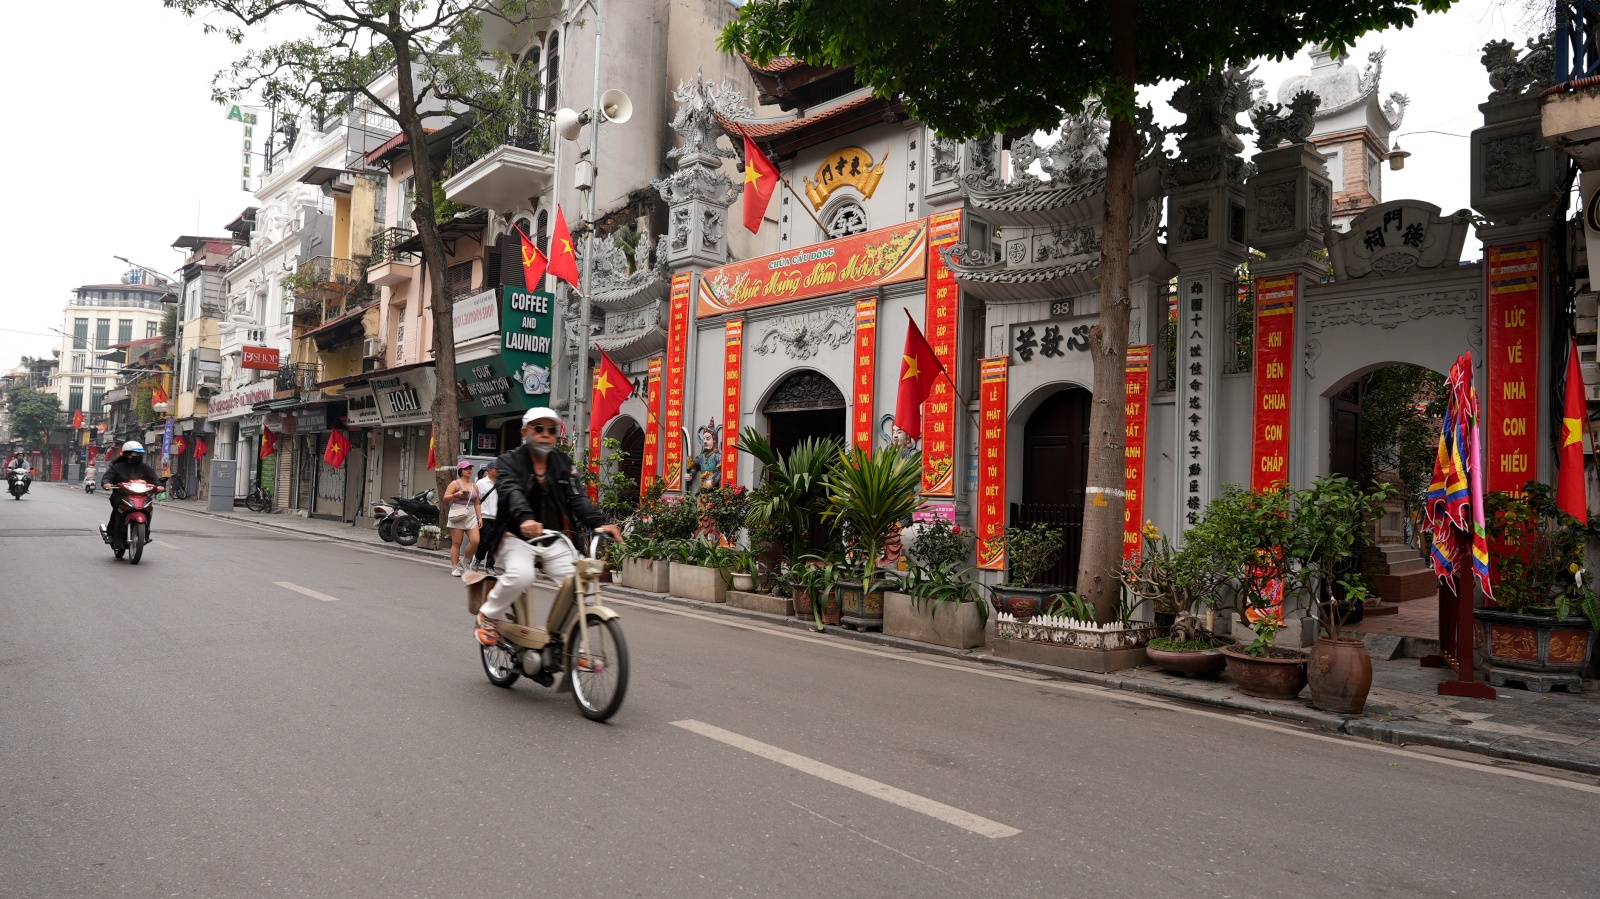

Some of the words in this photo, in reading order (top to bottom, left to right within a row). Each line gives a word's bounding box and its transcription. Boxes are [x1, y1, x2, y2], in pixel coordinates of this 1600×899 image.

[227, 105, 257, 125] A25
[243, 125, 253, 192] HOTEL
[768, 256, 790, 270] CHÙA
[733, 279, 763, 304] Chúc
[762, 269, 802, 297] Mừng
[804, 262, 838, 288] Năm
[511, 292, 548, 314] COFFEE
[1052, 302, 1070, 315] 38
[522, 316, 537, 329] AND
[1504, 304, 1526, 328] LÚC
[505, 331, 551, 354] LAUNDRY
[1268, 331, 1282, 348] KHI
[1507, 338, 1522, 364] VỀ
[471, 364, 492, 380] TOUR
[1266, 356, 1283, 379] ĐẾN
[466, 377, 511, 396] INFORMATION
[1126, 381, 1140, 398] IỆM
[1503, 376, 1527, 400] NHÀ
[387, 383, 417, 413] HOÀI
[480, 393, 507, 408] CENTRE
[1263, 389, 1286, 410] CHÙA
[986, 407, 1001, 422] PHẬT
[986, 425, 1001, 439] NHẤT
[1265, 425, 1282, 441] CON
[1503, 417, 1526, 436] CON
[932, 442, 945, 452] LAM
[1125, 446, 1141, 458] ANH
[1261, 449, 1283, 473] CHẮP
[1500, 448, 1528, 473] HIẾU
[987, 464, 997, 480] TỘI
[985, 483, 999, 499] DIỆT
